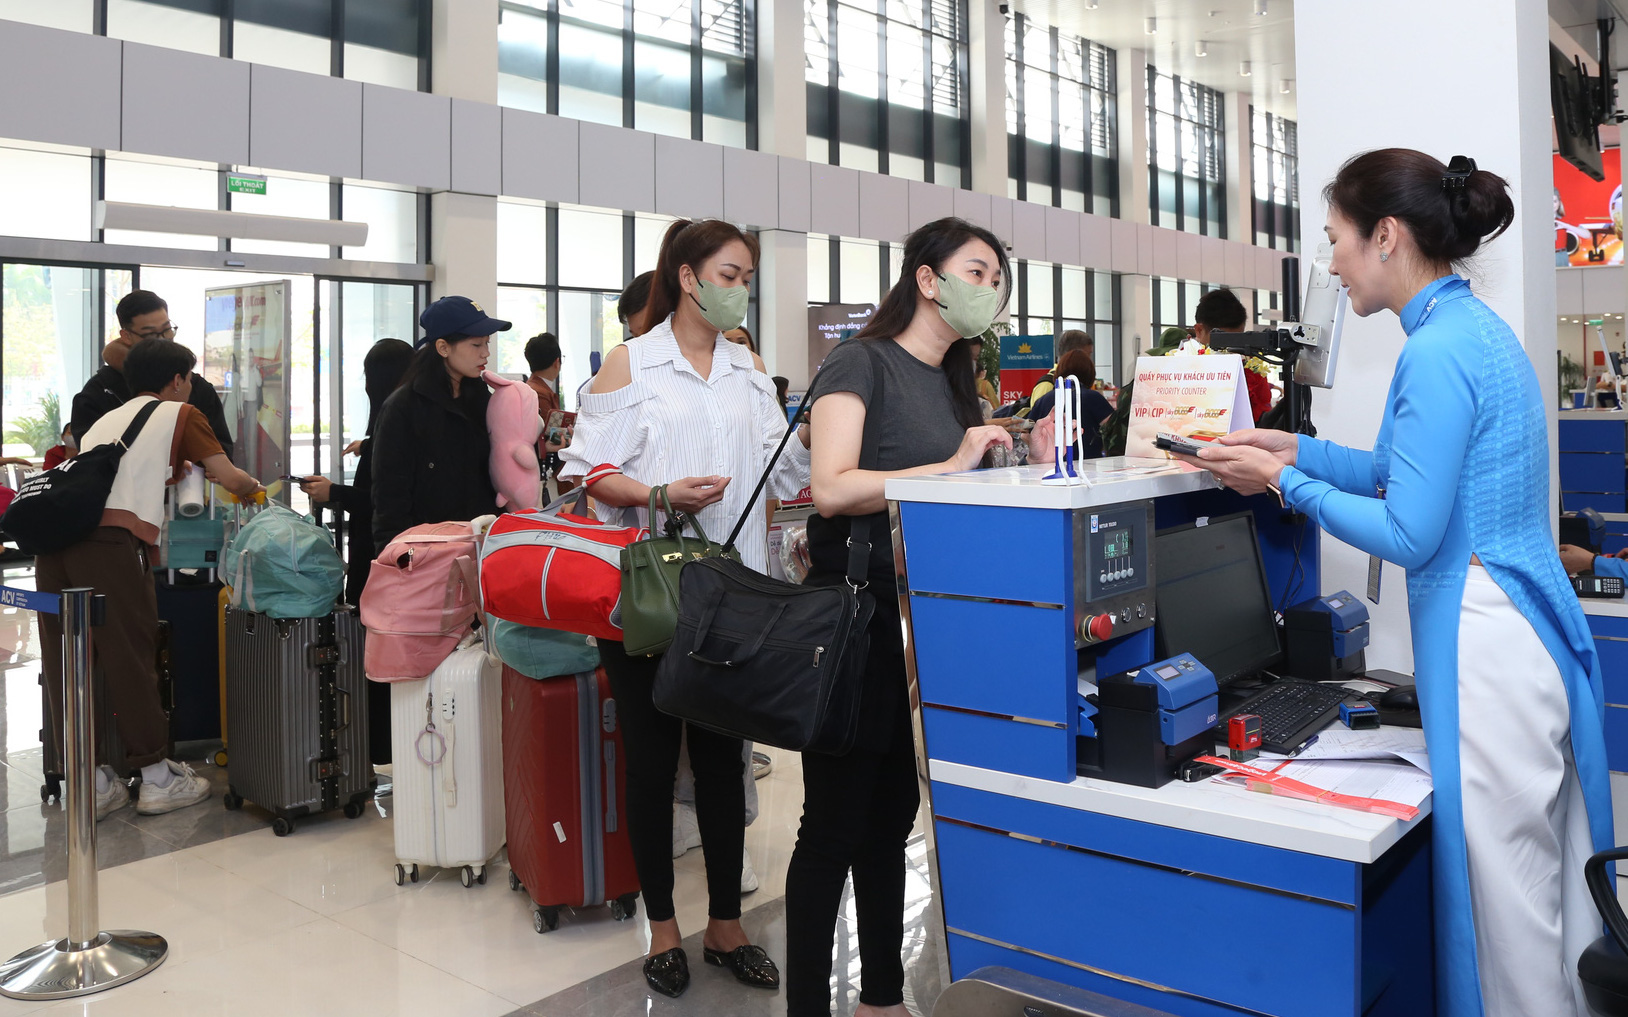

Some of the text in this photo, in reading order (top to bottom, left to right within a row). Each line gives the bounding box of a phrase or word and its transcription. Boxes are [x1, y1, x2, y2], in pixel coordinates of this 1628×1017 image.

[1183, 371, 1205, 381] KHÁCH
[1003, 391, 1022, 399] SKY
[1156, 387, 1207, 395] PRIORITY COUNTER
[1135, 408, 1147, 417] VIP
[1151, 408, 1164, 417] CIP
[1, 590, 15, 604] ACV
